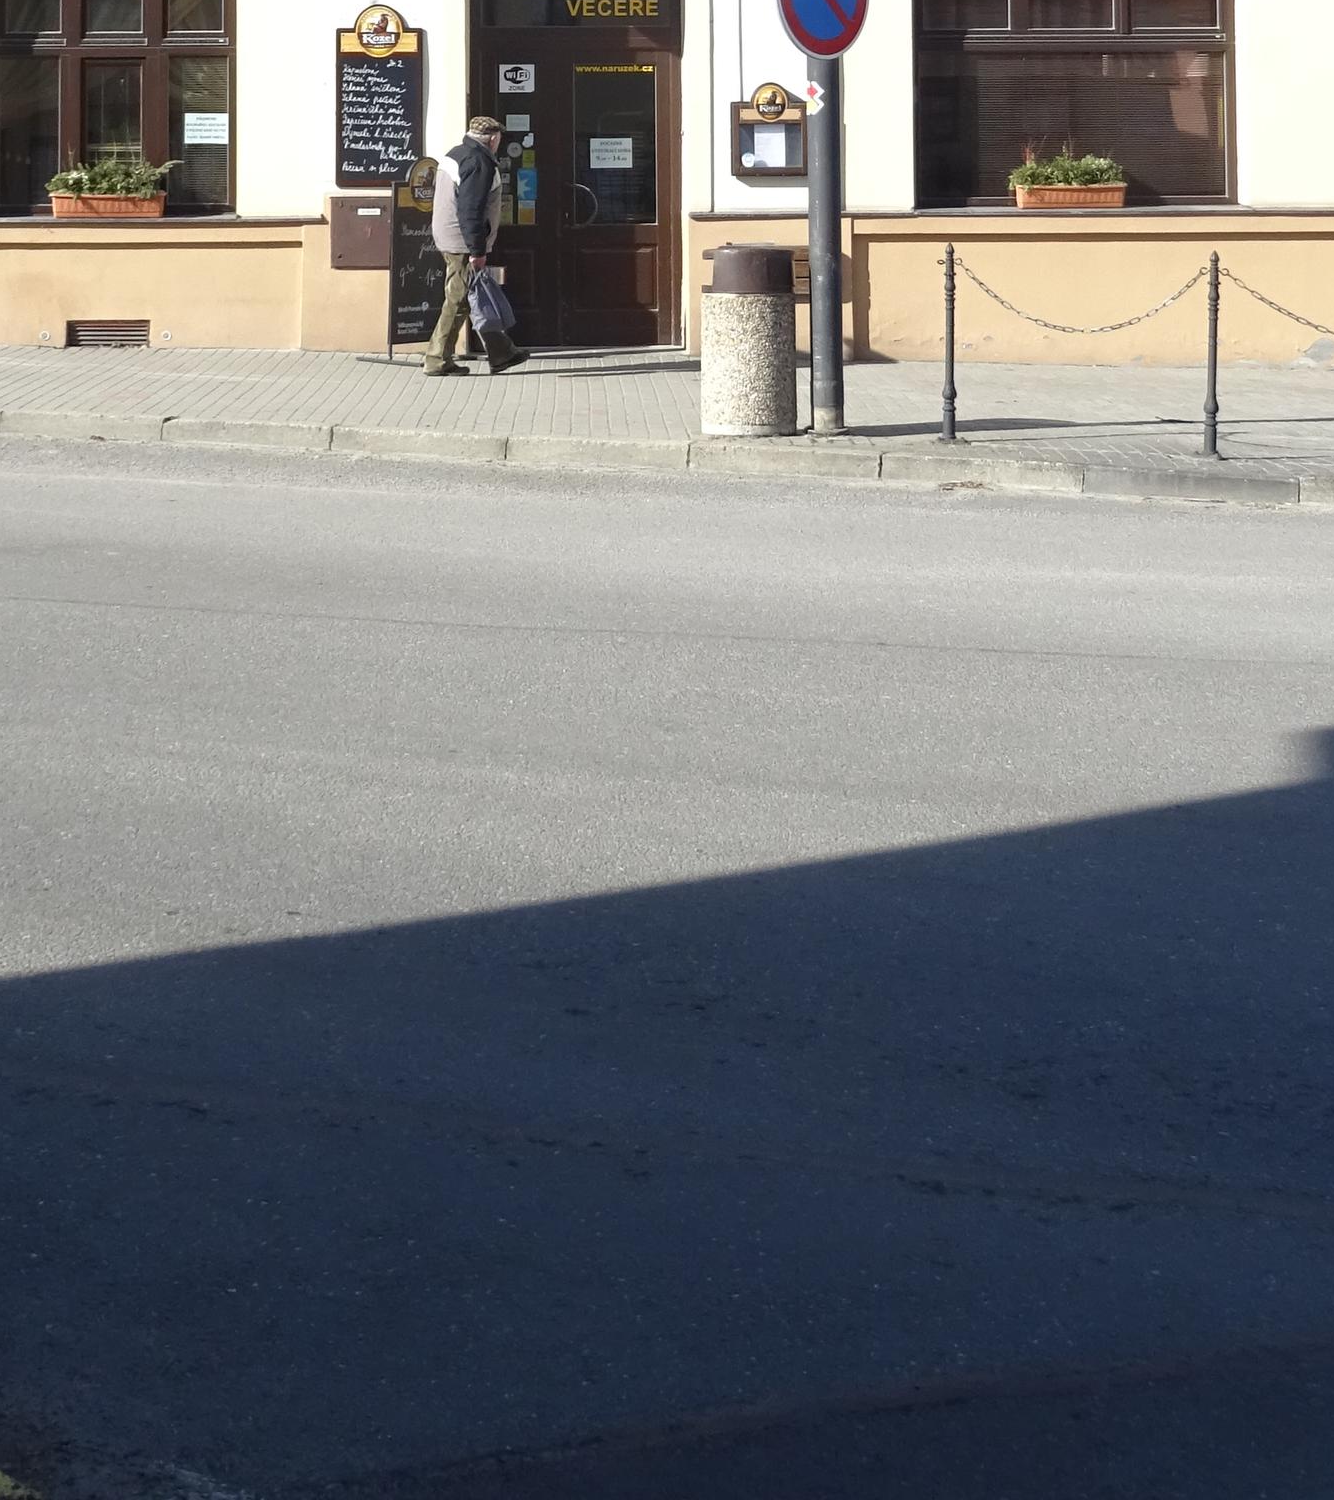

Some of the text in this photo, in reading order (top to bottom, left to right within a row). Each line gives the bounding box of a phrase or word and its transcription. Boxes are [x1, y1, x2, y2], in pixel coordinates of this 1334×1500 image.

[362, 33, 396, 45] Kozel
[575, 64, 654, 73] www.naruzek.cz
[414, 187, 434, 199] Koze
